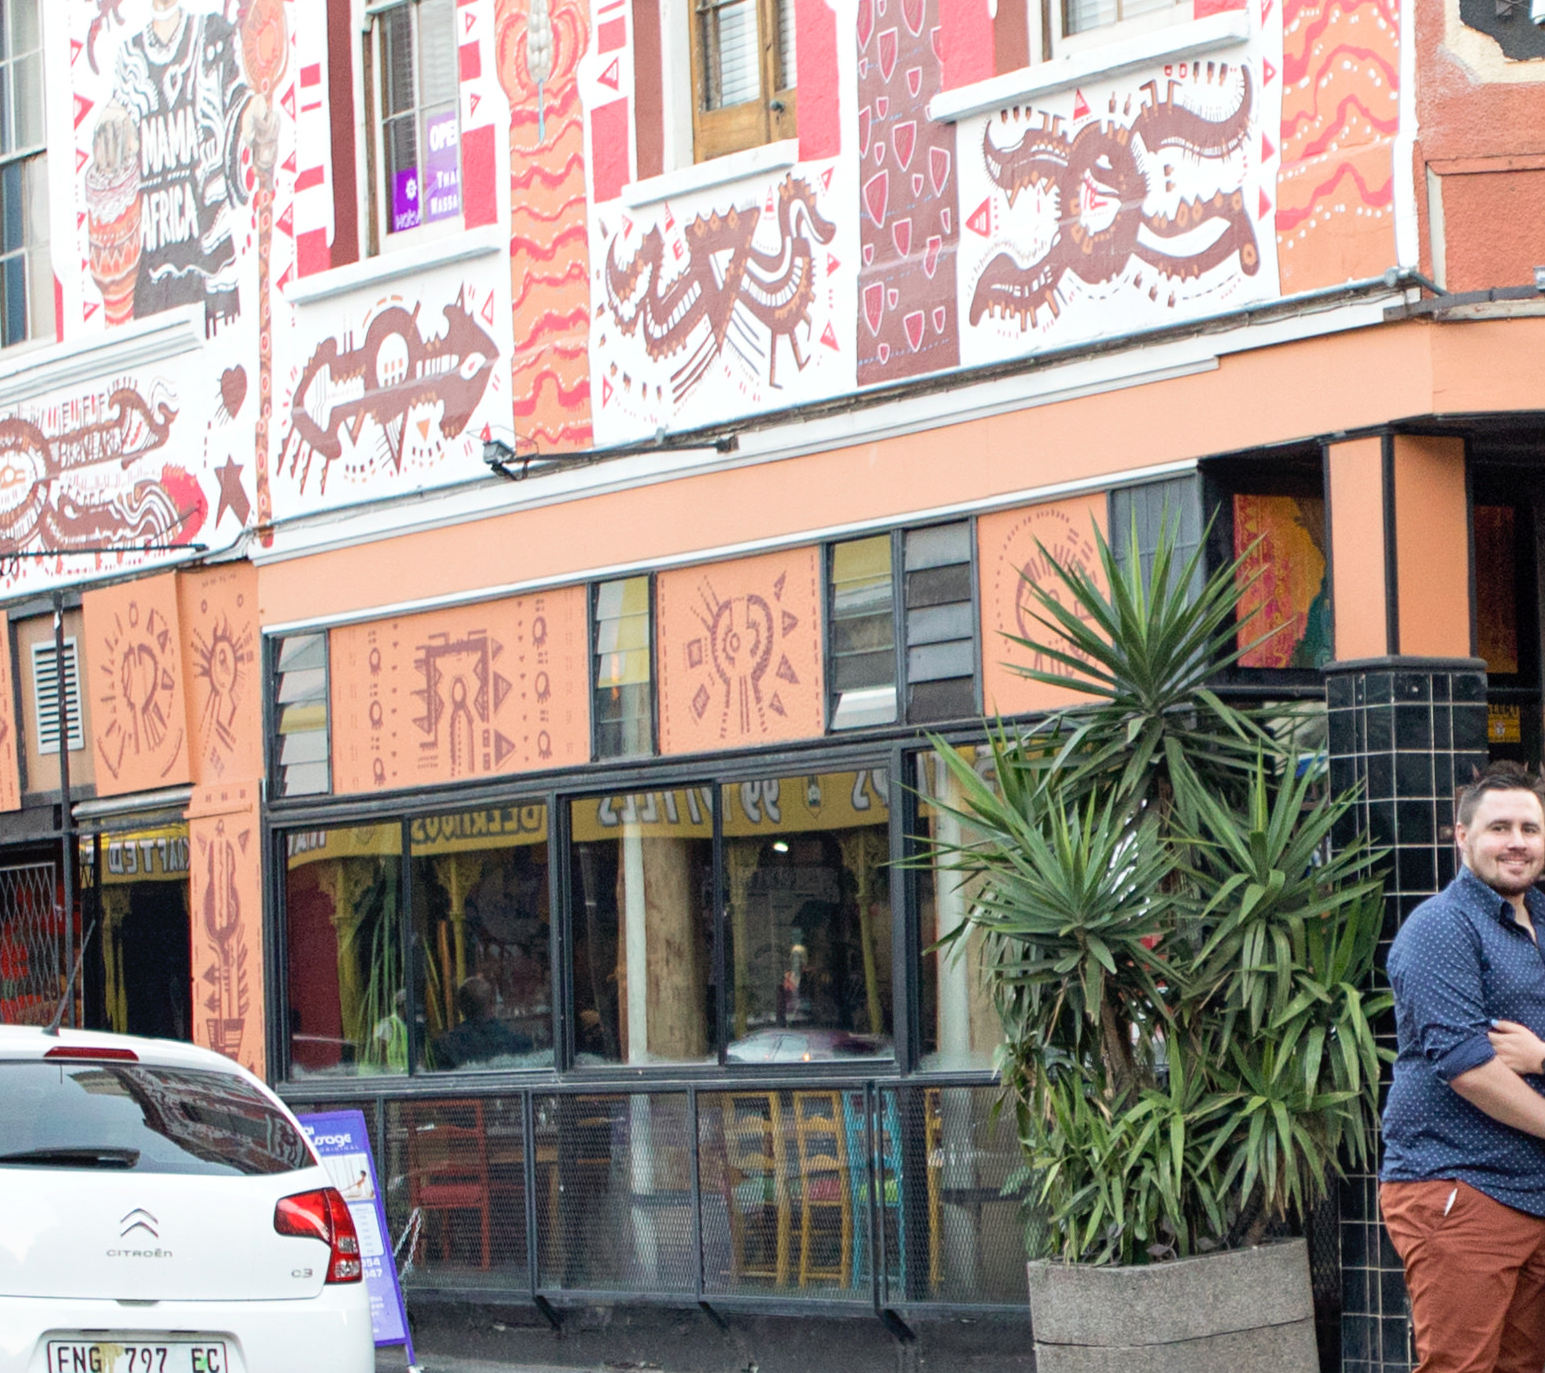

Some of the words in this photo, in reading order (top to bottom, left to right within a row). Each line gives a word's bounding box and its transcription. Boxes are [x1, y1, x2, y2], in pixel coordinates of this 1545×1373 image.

[141, 105, 198, 177] MAMA
[430, 119, 458, 153] OPE
[141, 182, 199, 252] AFRICA
[431, 194, 459, 215] MASSA
[57, 1346, 103, 1373] FNG
[125, 1347, 168, 1373] 797
